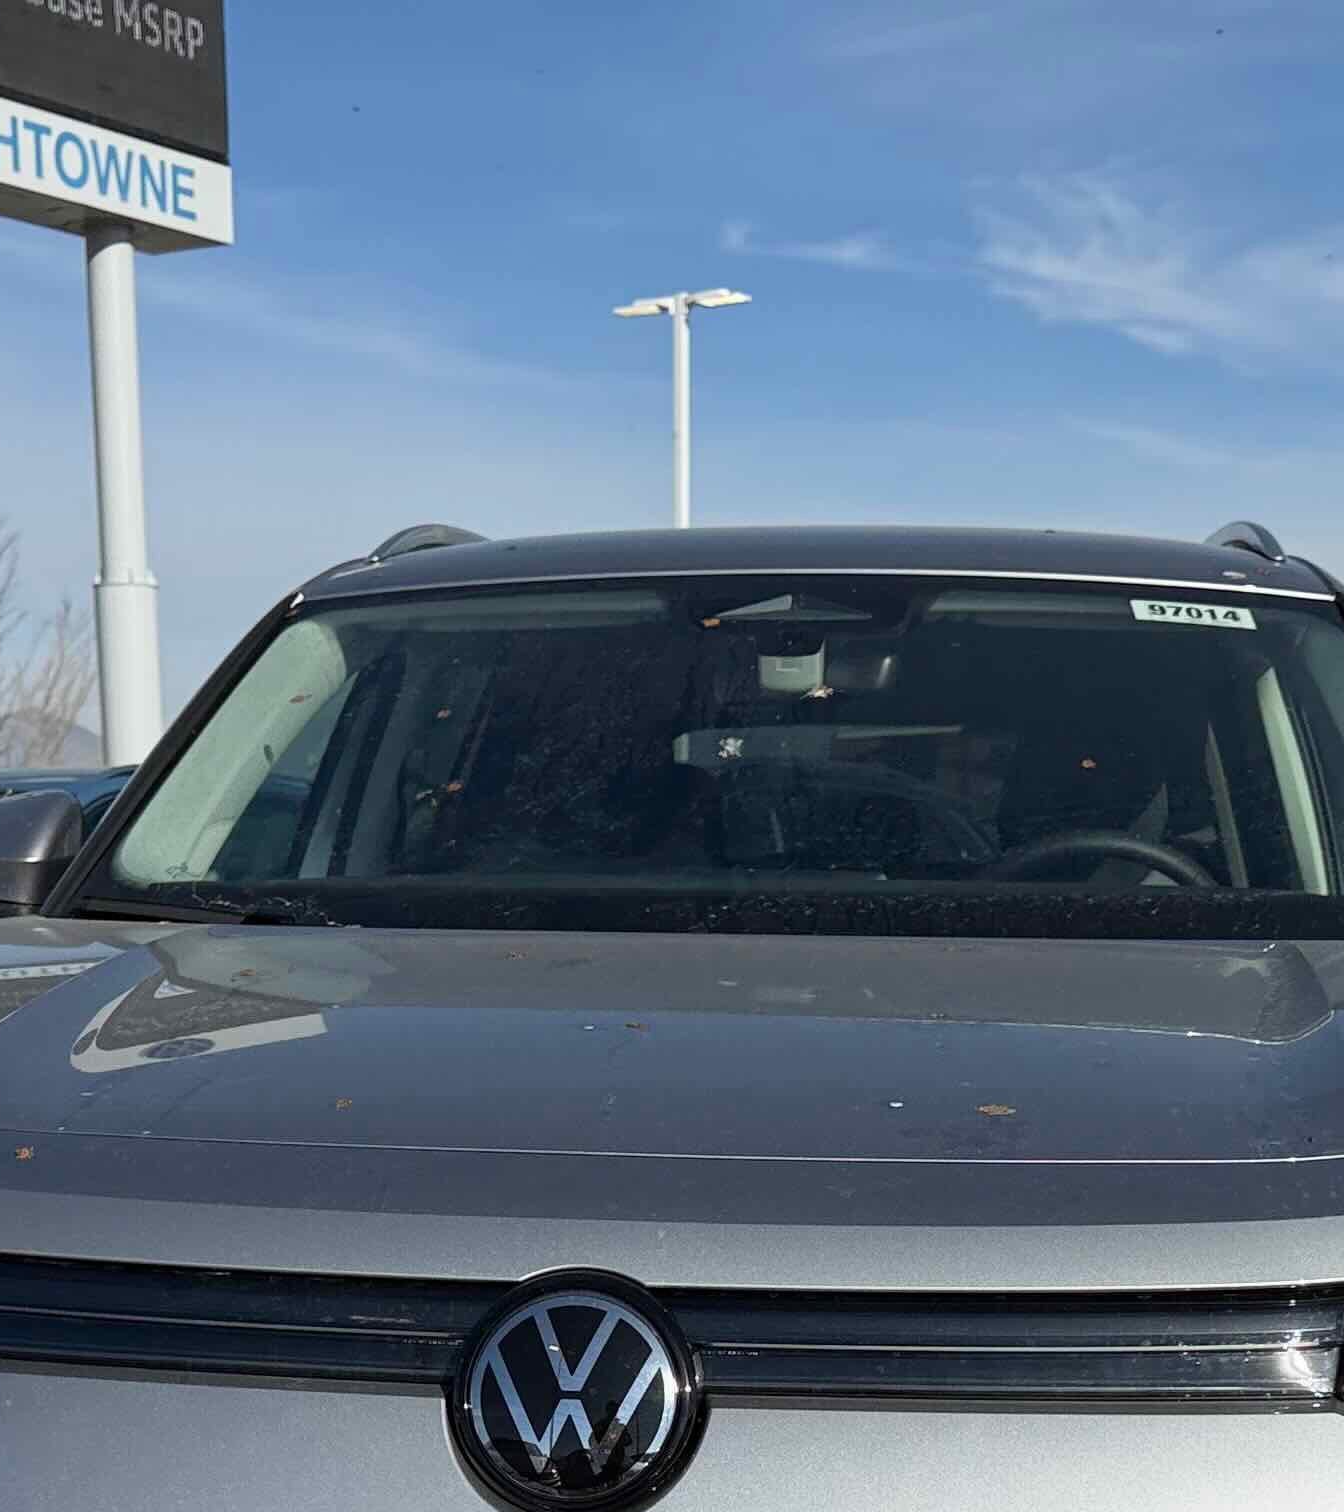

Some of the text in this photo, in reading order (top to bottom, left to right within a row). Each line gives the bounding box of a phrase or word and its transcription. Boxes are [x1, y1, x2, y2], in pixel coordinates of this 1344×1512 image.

[112, 0, 204, 60] MSRP
[1147, 603, 1241, 622] 97014
[468, 1292, 679, 1498] VW
